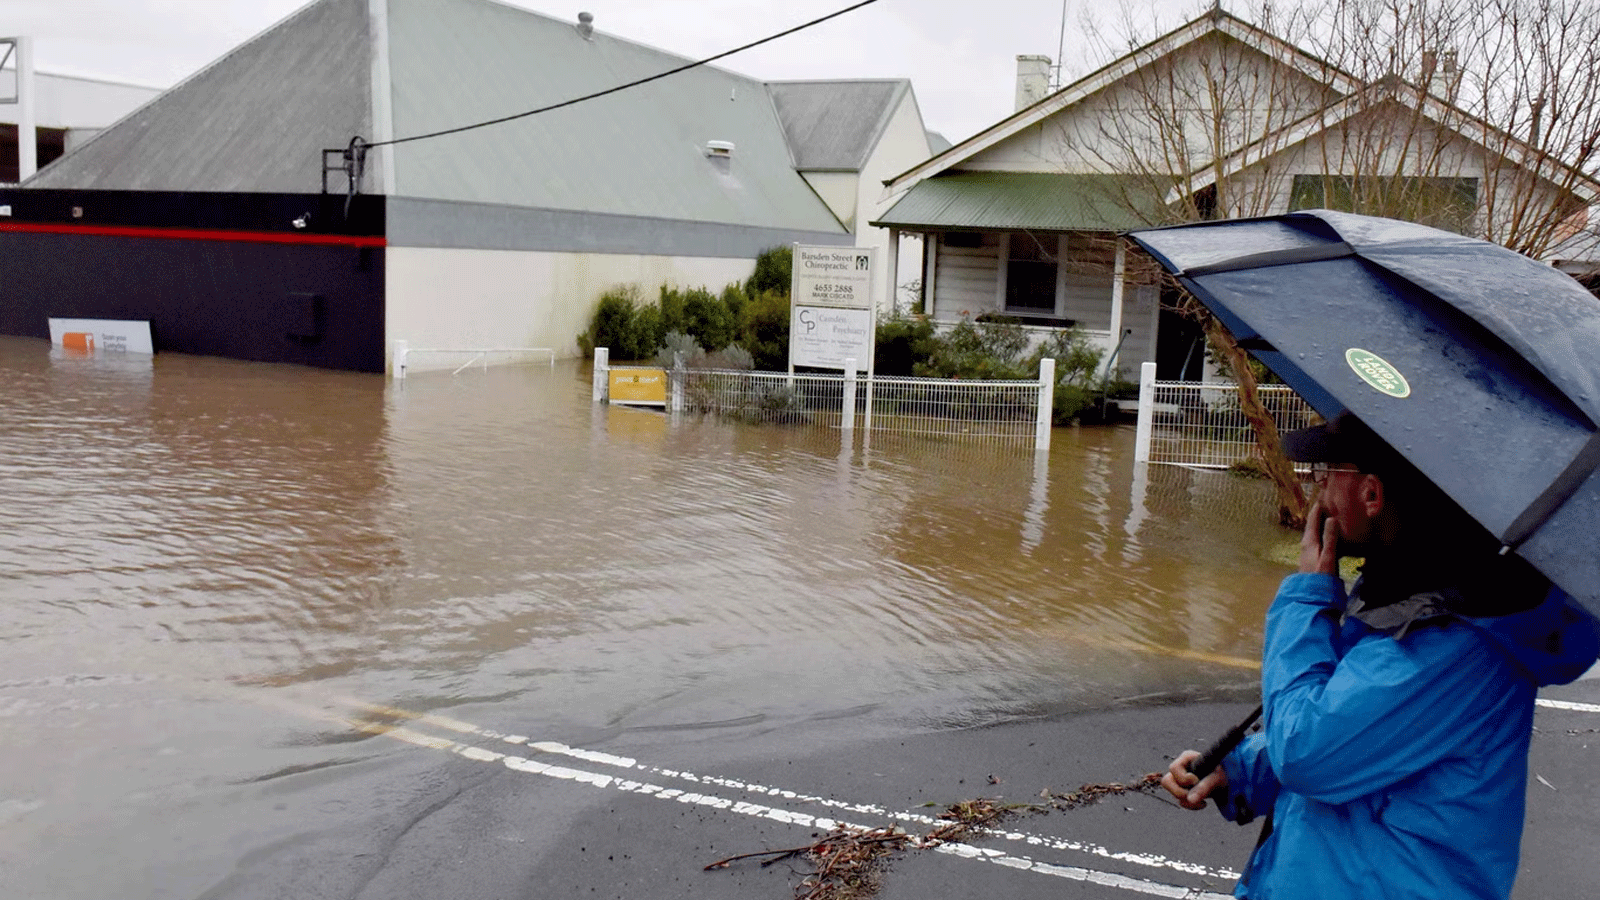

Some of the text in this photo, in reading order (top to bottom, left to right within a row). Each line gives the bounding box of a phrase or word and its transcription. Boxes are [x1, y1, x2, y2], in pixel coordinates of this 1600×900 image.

[801, 252, 853, 262] Barsden Street
[804, 260, 848, 271] Chiropractic
[814, 284, 853, 293] 4655 2888
[819, 314, 847, 323] Camden
[832, 325, 867, 337] Psychiatry
[1363, 357, 1395, 379] LAND
[1357, 363, 1396, 390] ROVER
